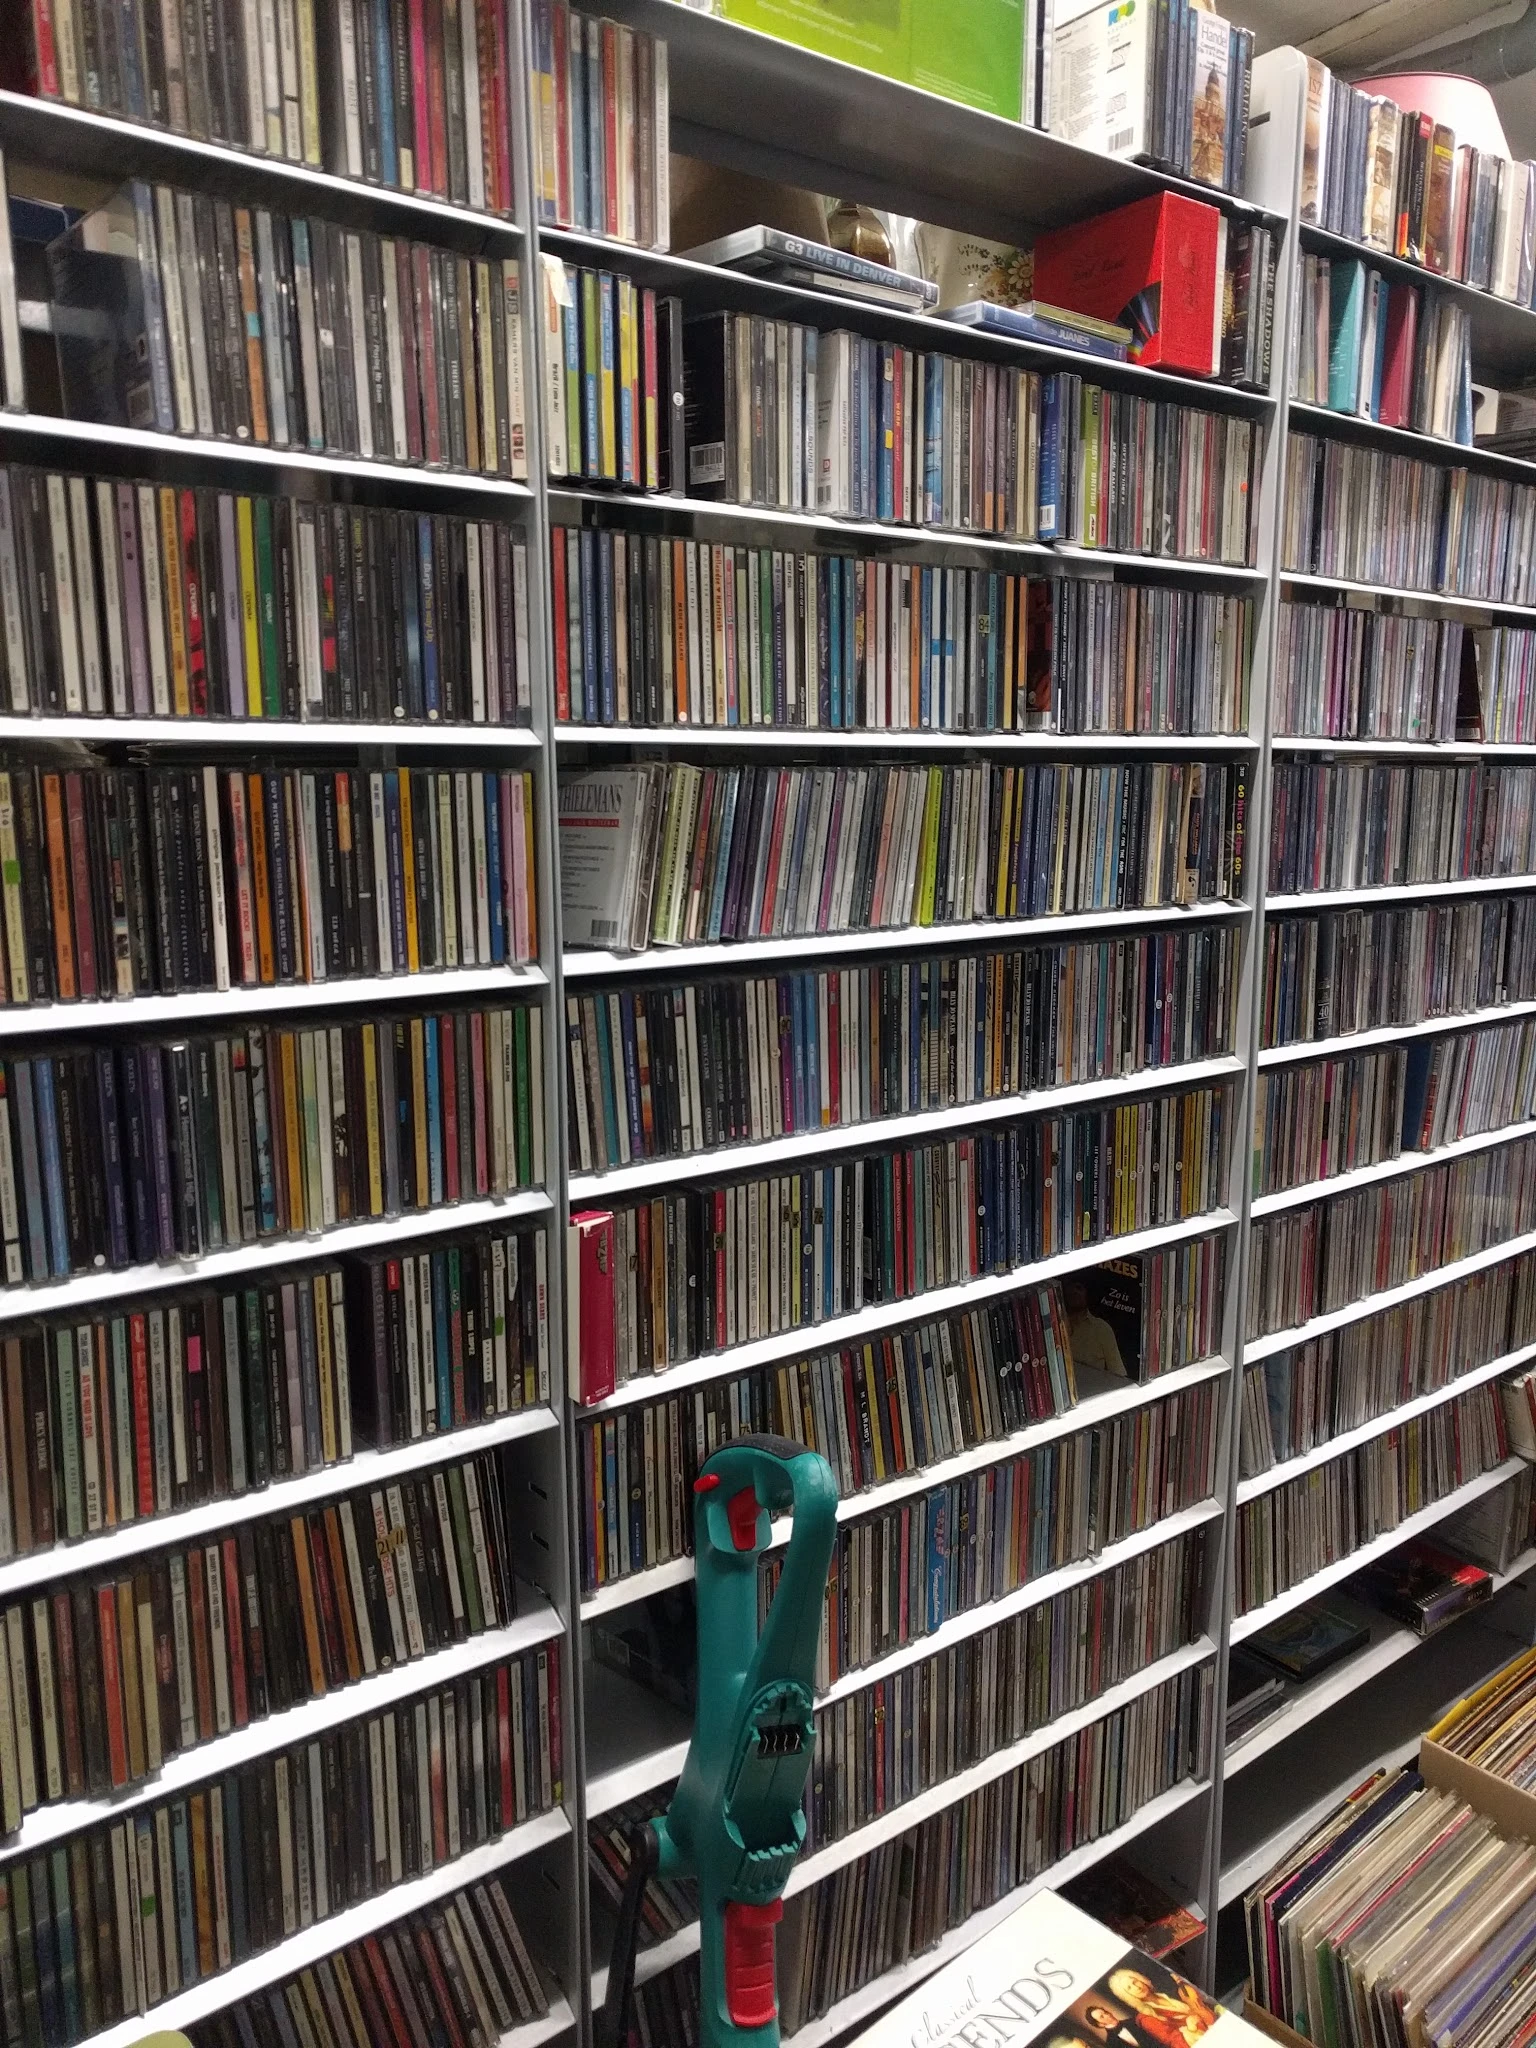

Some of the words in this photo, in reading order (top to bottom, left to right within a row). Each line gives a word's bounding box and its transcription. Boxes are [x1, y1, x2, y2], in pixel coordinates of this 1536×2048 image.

[785, 239, 804, 256] G3
[805, 246, 835, 266] LIVE
[836, 256, 851, 270] IN
[852, 262, 902, 288] DENVER
[1267, 262, 1275, 284] THE
[1058, 328, 1091, 346] JUANES
[1261, 288, 1274, 375] SHADOWS
[451, 359, 460, 399] TIMELESS
[270, 780, 278, 800] GUY
[1238, 784, 1245, 798] 60
[1237, 800, 1245, 821] hits
[272, 802, 281, 849] MITCHELL
[1236, 823, 1245, 834] of
[195, 838, 203, 862] DION
[276, 857, 284, 896] SINGING
[278, 898, 286, 916] THE
[279, 918, 287, 949] BLUES
[184, 1181, 195, 1207] High
[1100, 1297, 1114, 1307] het
[1114, 1302, 1136, 1314] leven
[1109, 1288, 1121, 1298] Zo
[1122, 1293, 1130, 1301] is
[467, 1309, 475, 1331] TRINI
[81, 1348, 90, 1367] JONES
[153, 1362, 163, 1389] SHERYL
[155, 1390, 164, 1413] CROW
[35, 1411, 45, 1436] PERCY
[85, 1422, 94, 1439] LOVE
[861, 1412, 870, 1444] BRANDT
[37, 1438, 48, 1470] SLEDGE
[387, 1577, 396, 1597] HITS
